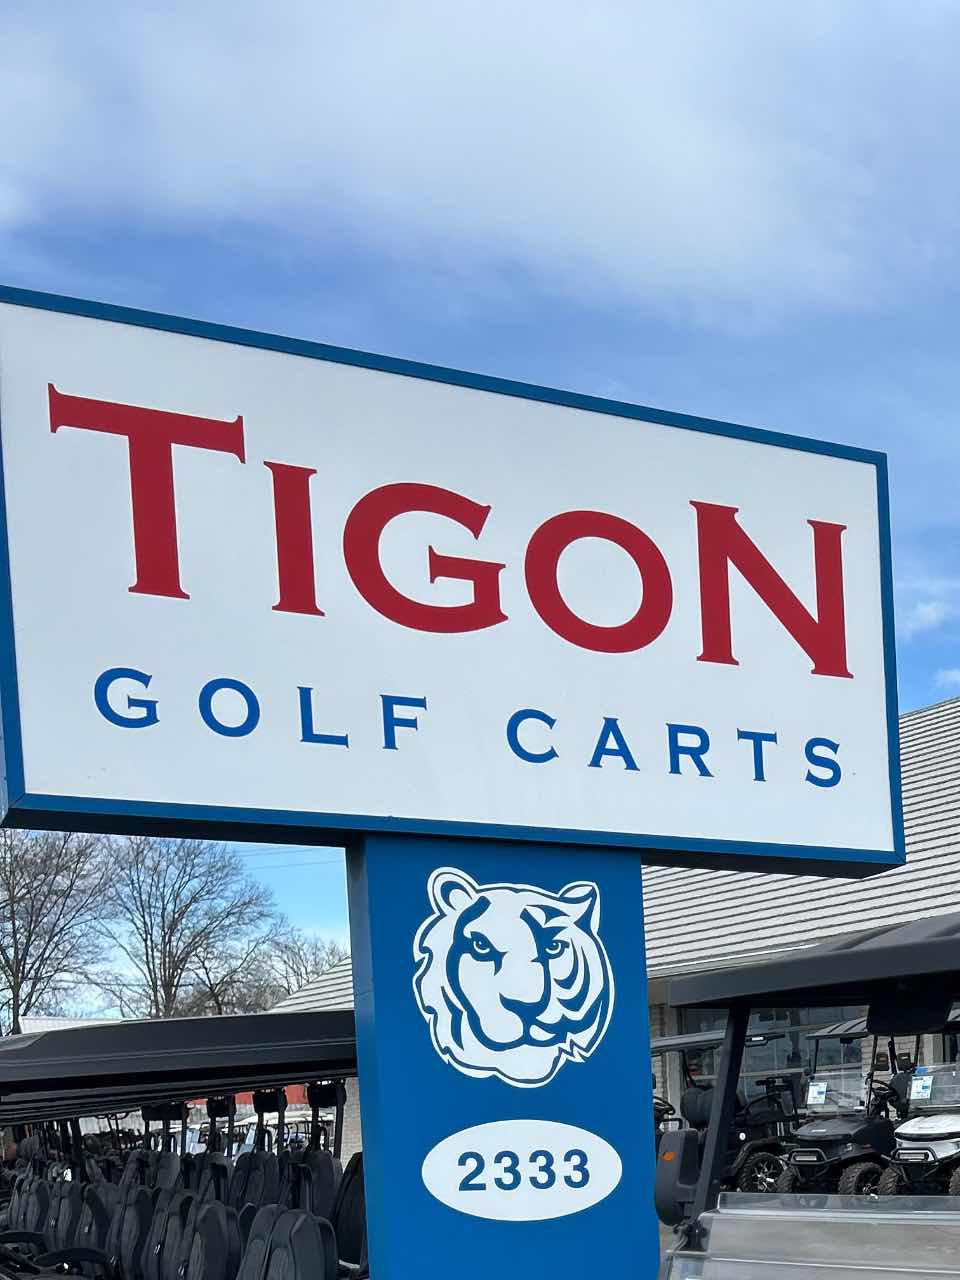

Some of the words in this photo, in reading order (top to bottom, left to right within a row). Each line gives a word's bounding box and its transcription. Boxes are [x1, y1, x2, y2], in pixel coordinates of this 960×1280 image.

[49, 384, 853, 678] TIGON
[94, 667, 427, 751] GOLF
[507, 708, 842, 788] CARTS
[457, 1149, 591, 1192] 2333
